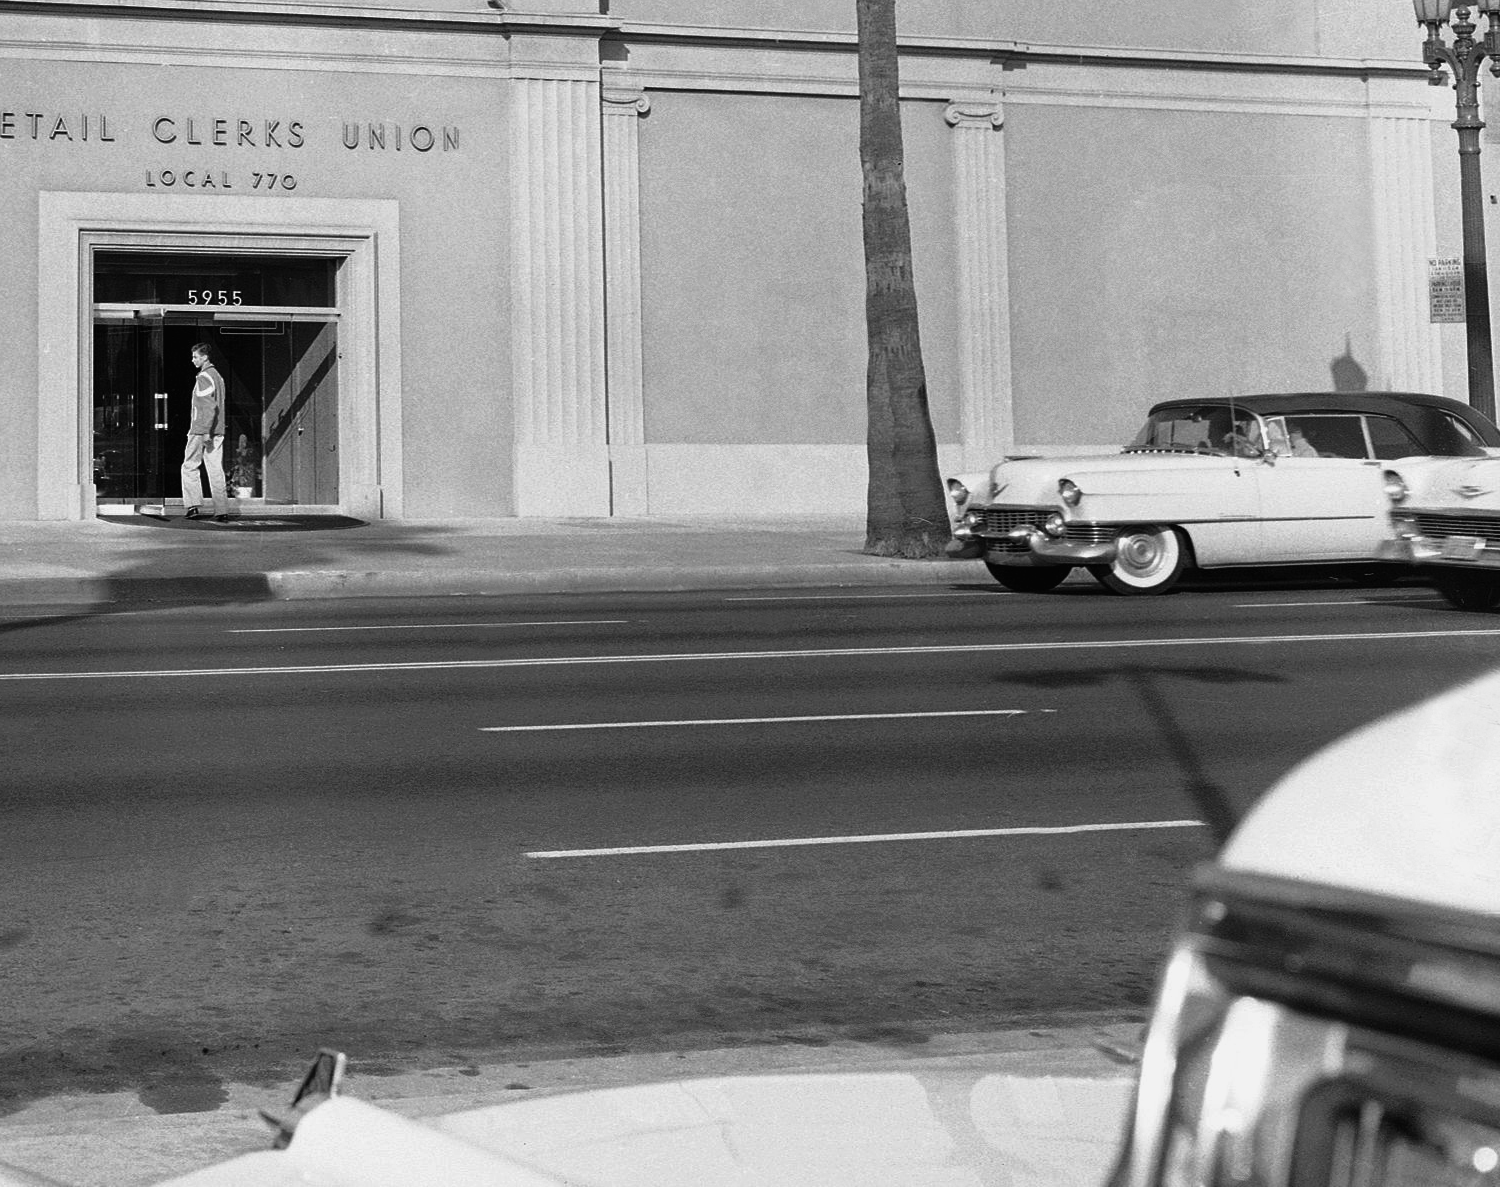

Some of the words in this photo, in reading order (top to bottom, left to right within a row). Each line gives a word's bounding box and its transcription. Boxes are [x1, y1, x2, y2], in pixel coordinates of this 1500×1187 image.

[151, 116, 305, 149] CLERKS
[342, 123, 460, 152] UNION
[145, 168, 232, 189] LOCAL
[251, 172, 298, 190] 770
[188, 289, 242, 305] 5955
